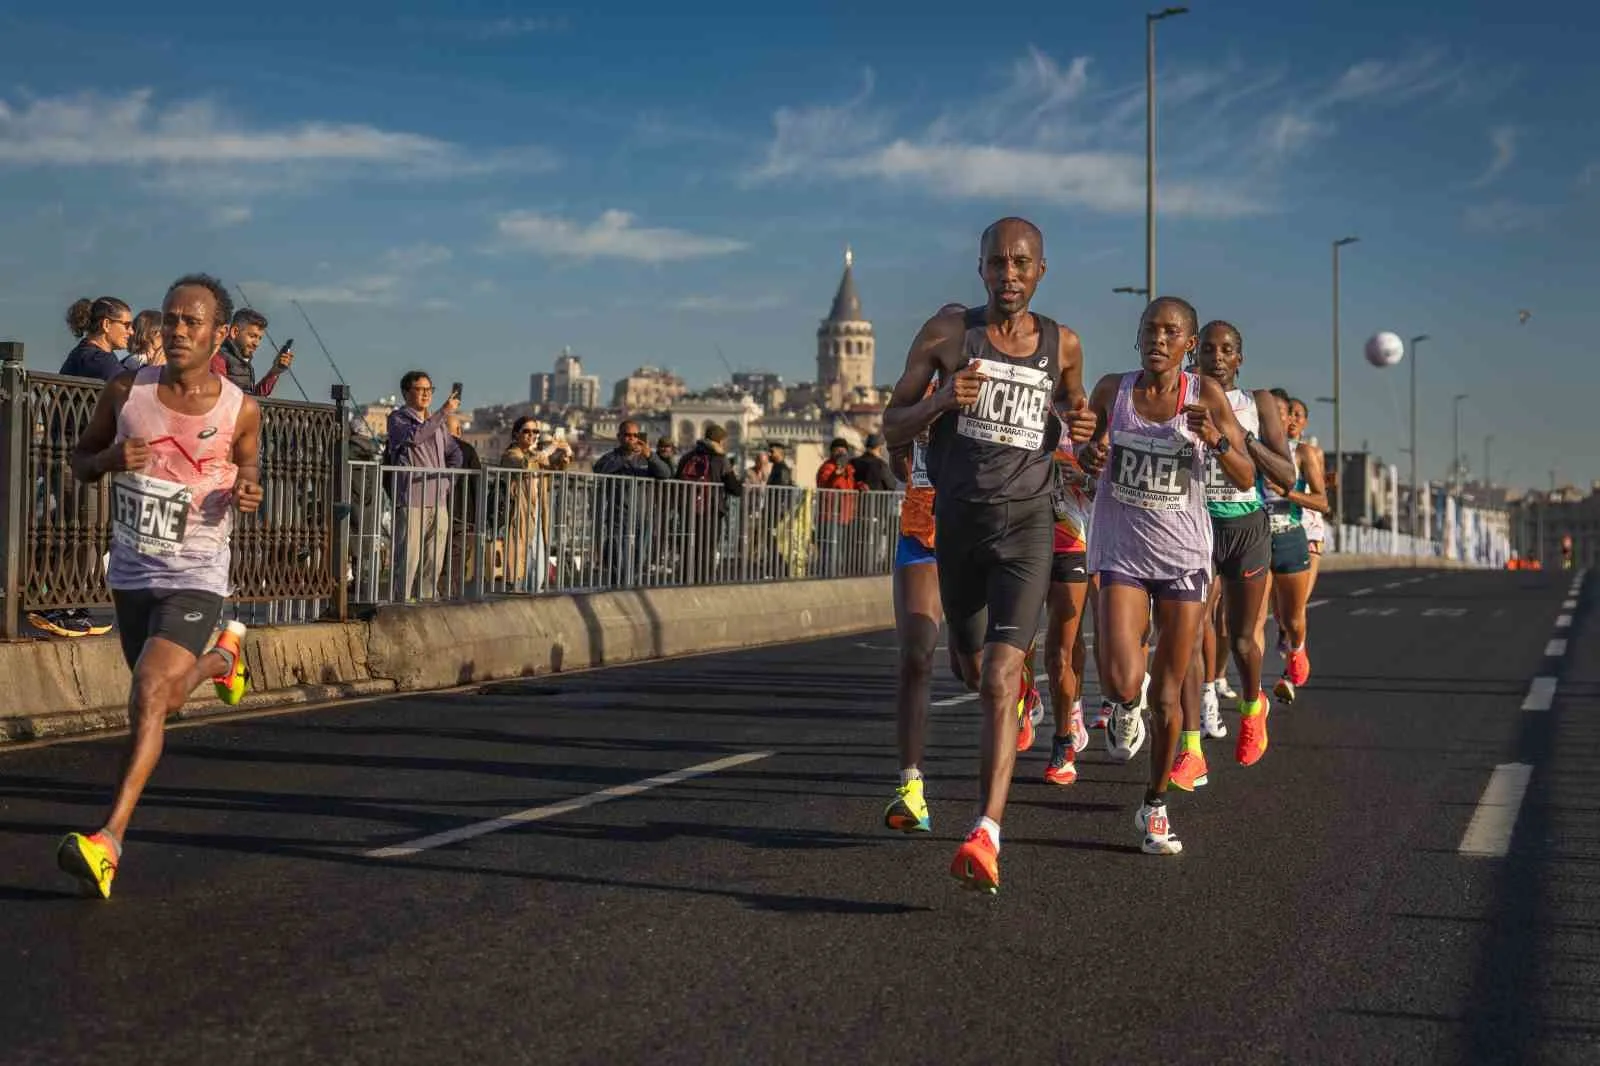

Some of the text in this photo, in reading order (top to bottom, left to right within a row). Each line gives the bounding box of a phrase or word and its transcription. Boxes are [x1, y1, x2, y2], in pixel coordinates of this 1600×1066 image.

[965, 380, 1045, 430] MICHAEL
[1000, 426, 1039, 439] MARATHON
[1119, 449, 1182, 493] RAEL
